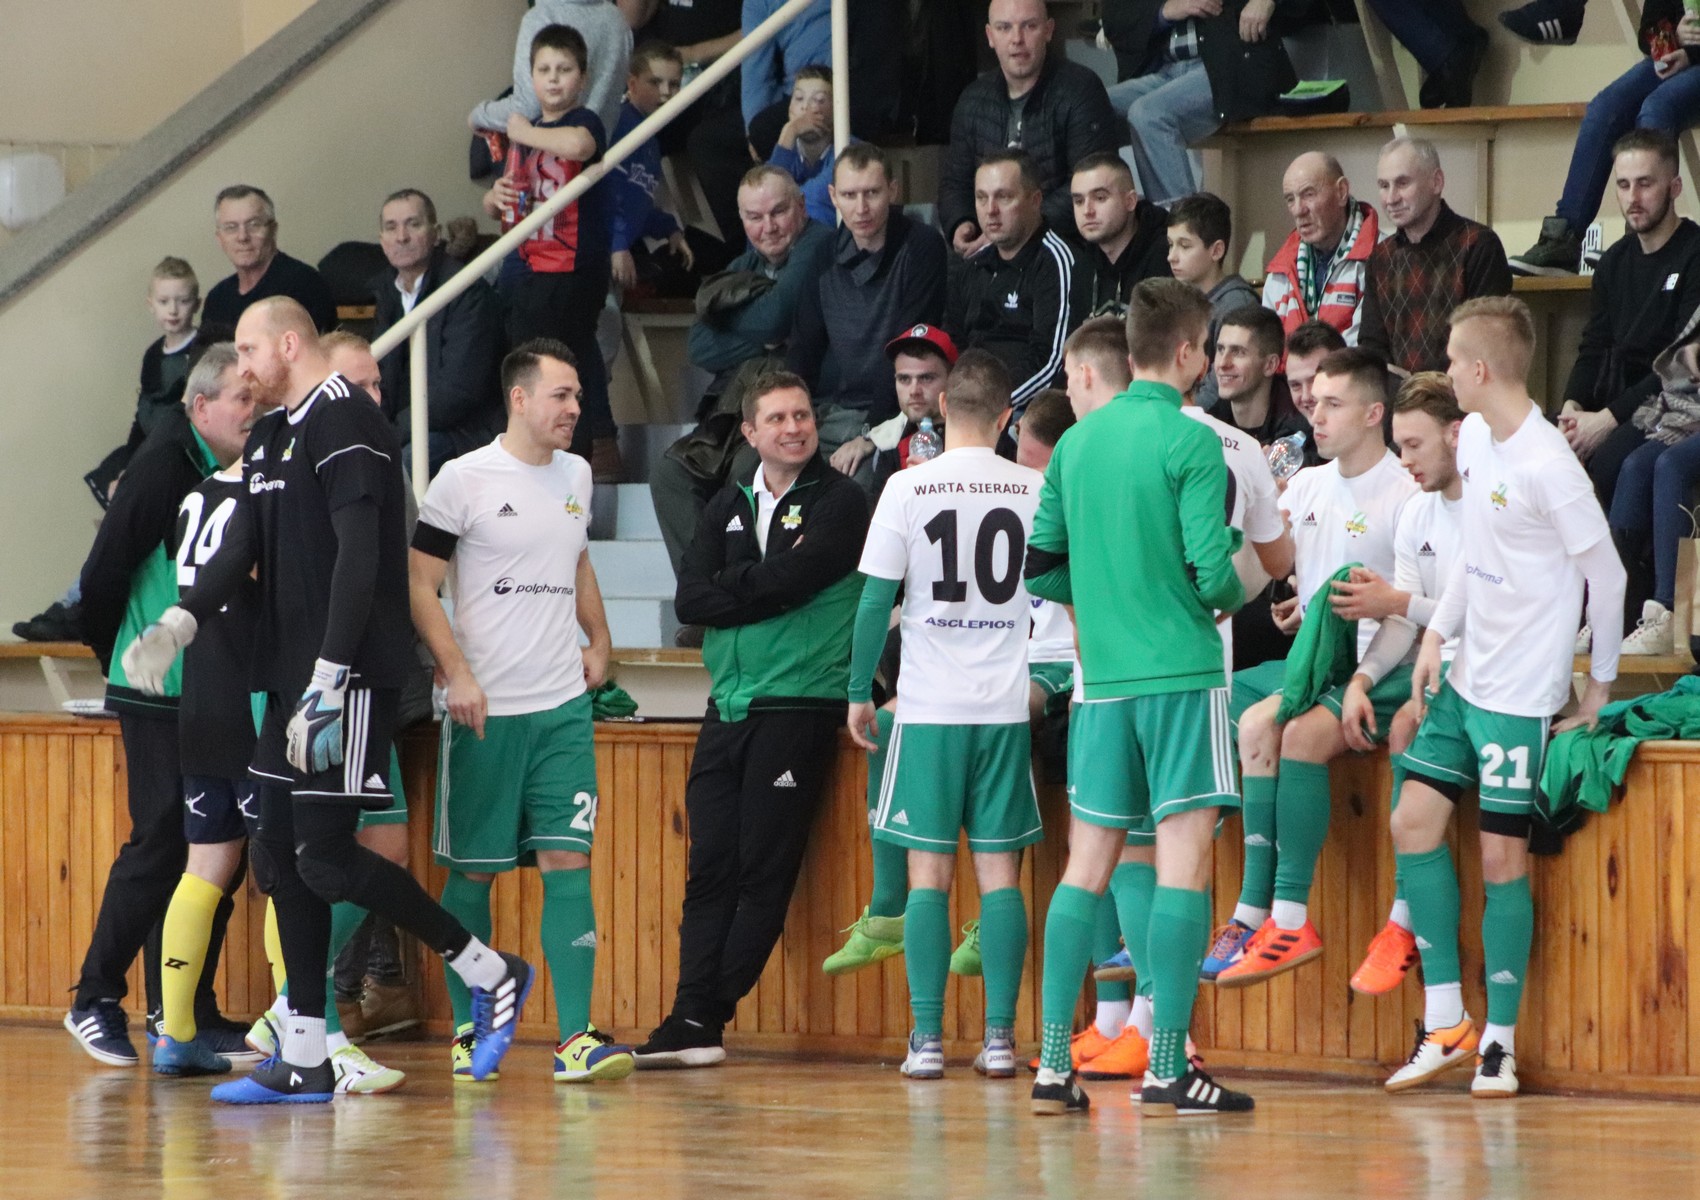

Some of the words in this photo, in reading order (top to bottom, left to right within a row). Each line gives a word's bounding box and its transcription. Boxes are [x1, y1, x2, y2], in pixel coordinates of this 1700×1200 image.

[914, 482, 965, 496] WARTA
[969, 482, 1029, 495] SIERADZ
[923, 507, 1026, 605] 10
[515, 582, 574, 596] polpharma
[925, 616, 1015, 630] ASCLEPIOS
[1480, 742, 1532, 789] 21
